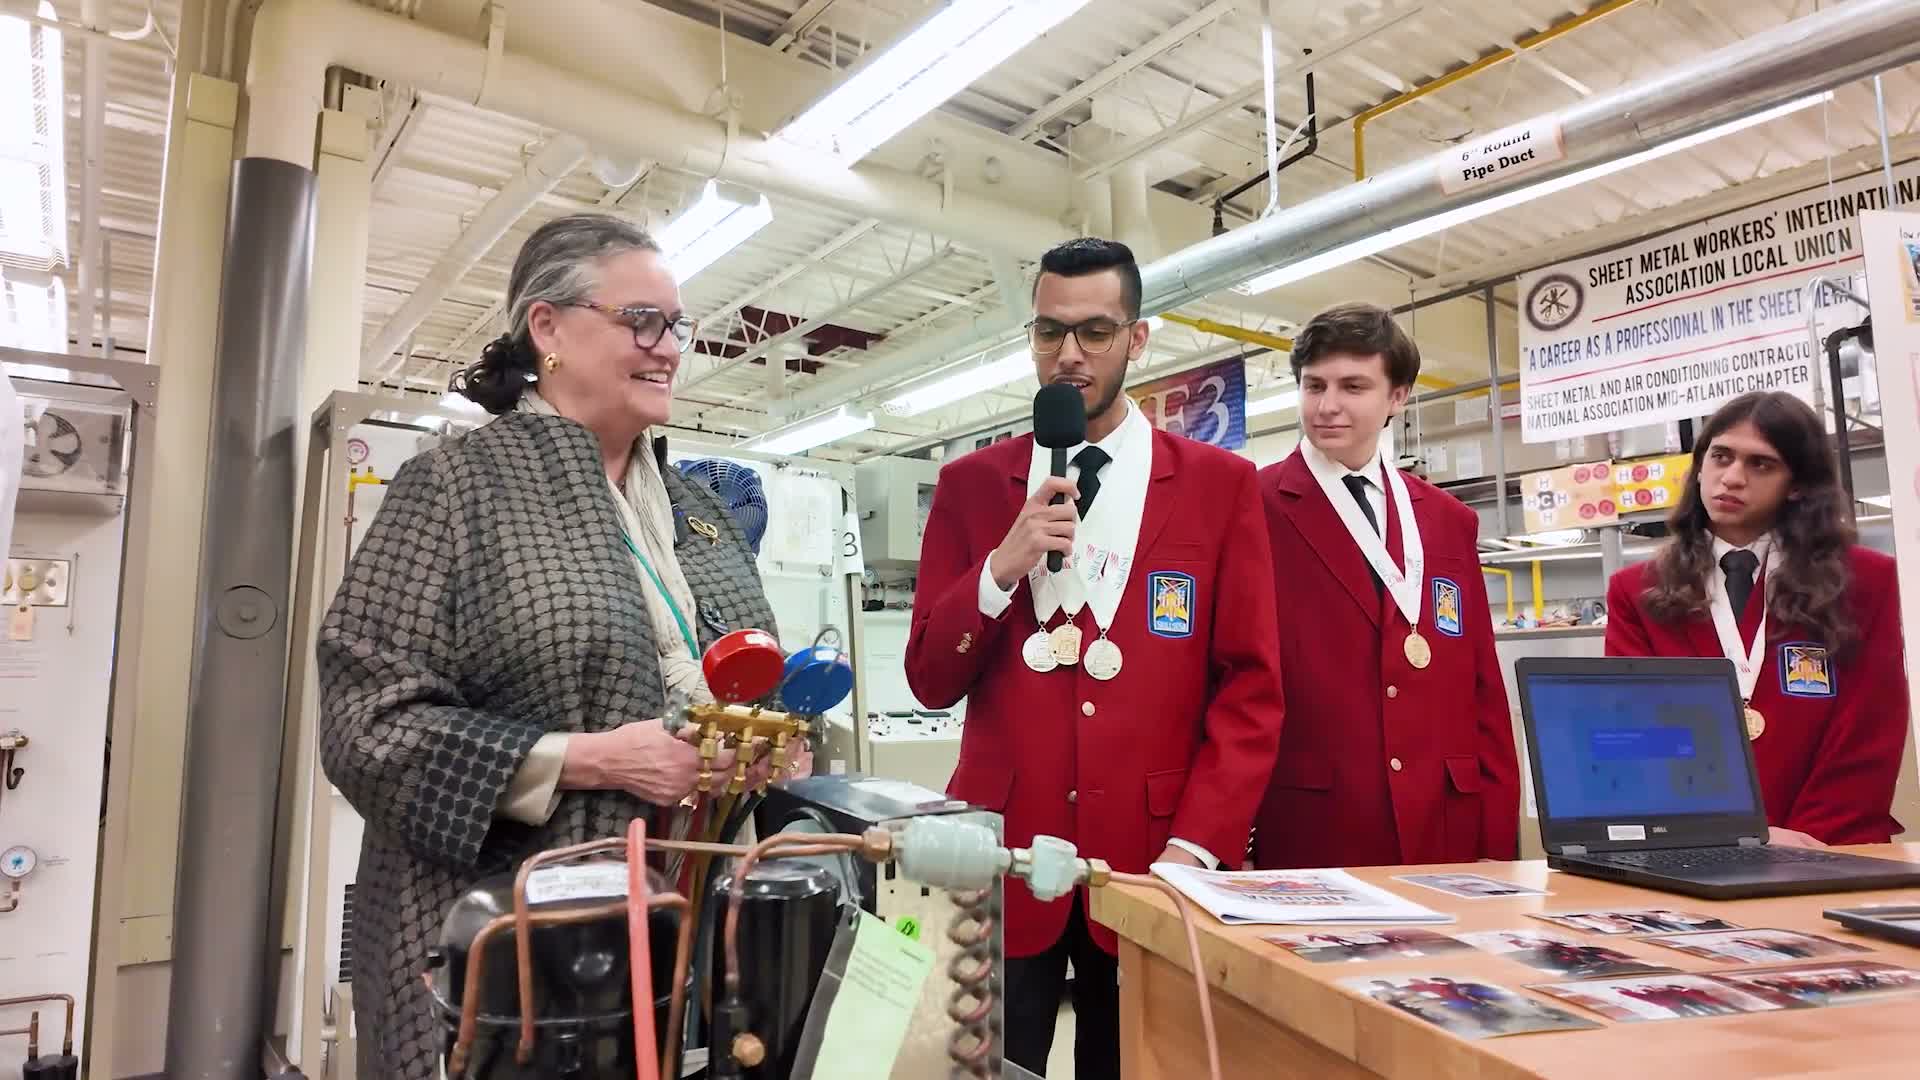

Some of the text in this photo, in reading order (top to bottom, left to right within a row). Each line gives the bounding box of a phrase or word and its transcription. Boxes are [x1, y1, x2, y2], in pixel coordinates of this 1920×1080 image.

[1462, 148, 1535, 180] Pipe Duct
[1589, 257, 1633, 288] SHEET
[1640, 242, 1689, 274] METAL
[1694, 211, 1778, 259] WORKERS'
[1626, 227, 1853, 305] ASSOCIATION LOCAL UNION
[1540, 339, 1581, 368] CAREER
[1586, 335, 1600, 359] AS
[1604, 332, 1615, 356] A
[1617, 311, 1708, 353] PROFESSIONAL
[1711, 304, 1725, 331] IN
[1728, 298, 1753, 325] THE
[1759, 287, 1802, 321] SHEET
[1527, 337, 1827, 410] SHEET METAL AND AIR CONDITIONING CONTRACTOS
[1527, 410, 1579, 431] NATIONAL
[1583, 397, 1654, 417] ASSOCIATION
[1657, 376, 1744, 405] MID-ATLANTIC
[1748, 365, 1808, 392] CHAPTER
[843, 532, 858, 557] 3
